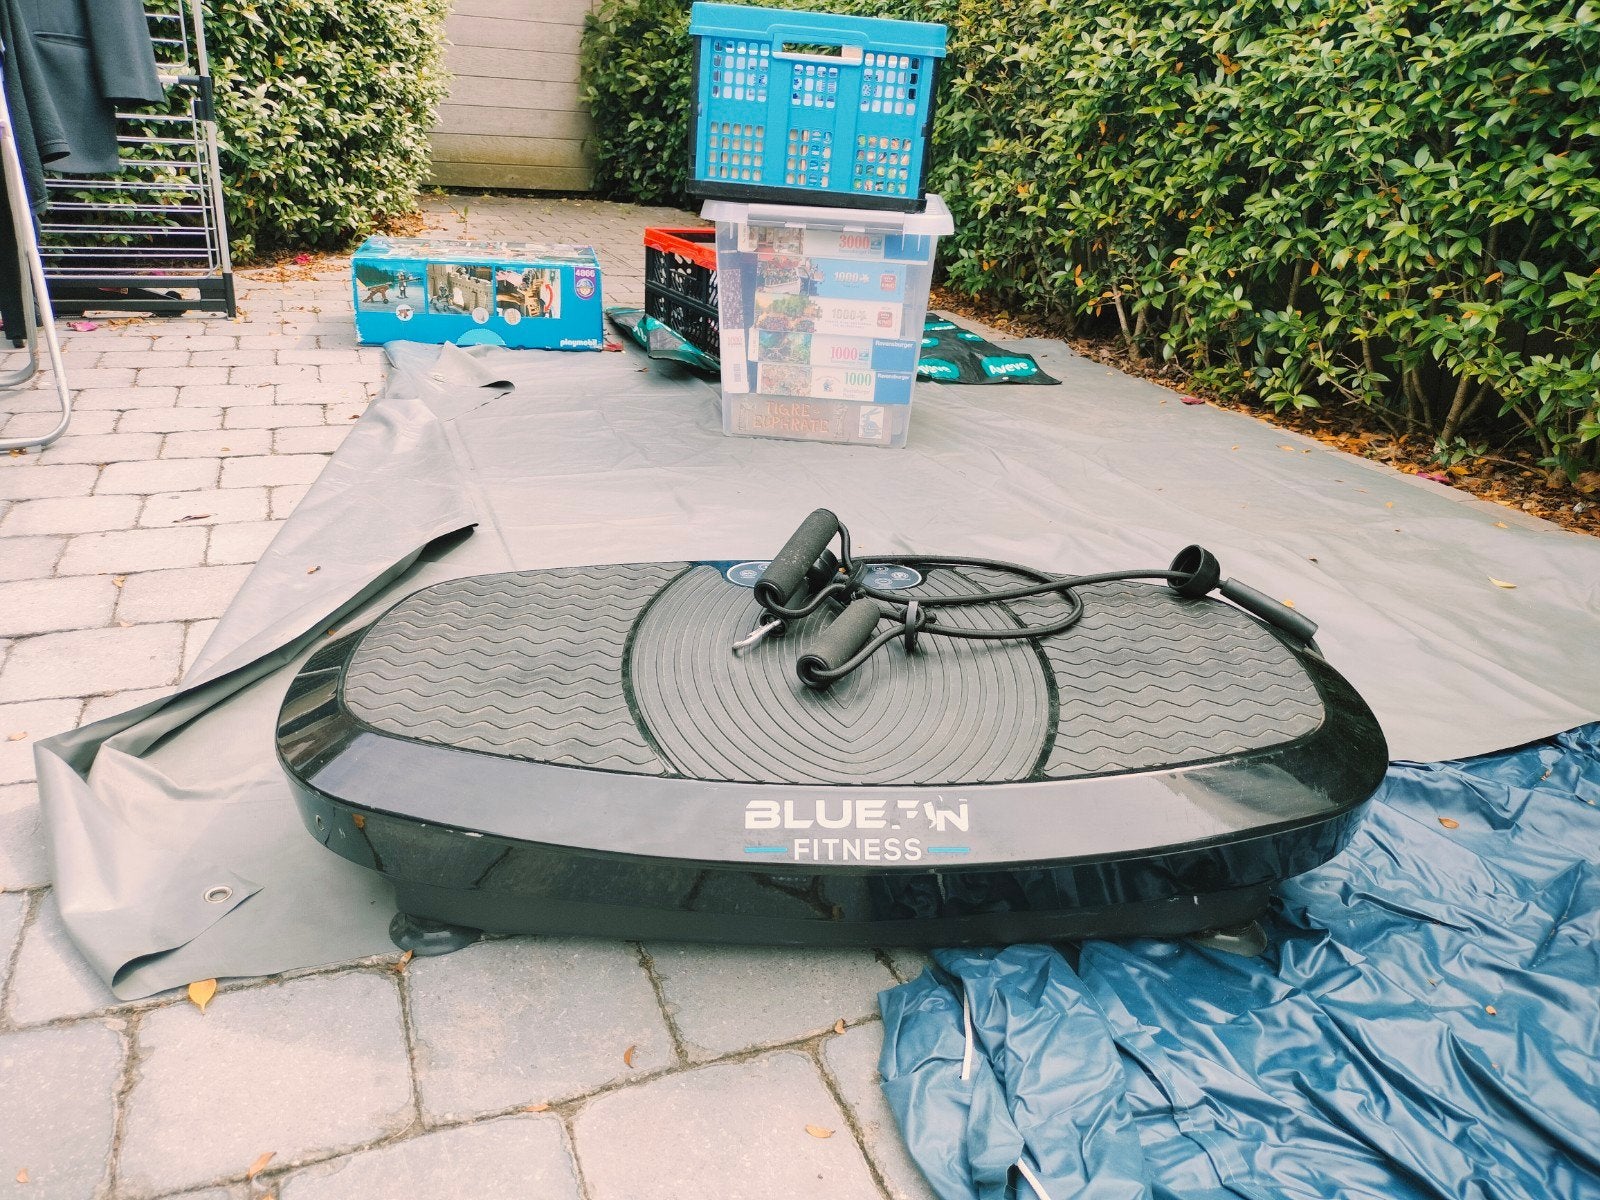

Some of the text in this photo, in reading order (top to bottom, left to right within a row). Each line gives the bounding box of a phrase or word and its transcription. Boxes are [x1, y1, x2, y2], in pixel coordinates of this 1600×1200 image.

[839, 234, 870, 249] 3000
[560, 338, 598, 348] playmobil
[875, 339, 914, 349] Ravensburger
[831, 346, 858, 360] 1000
[844, 372, 872, 386] 1000
[766, 400, 811, 417] TIGRE
[793, 837, 922, 861] FITNESS
